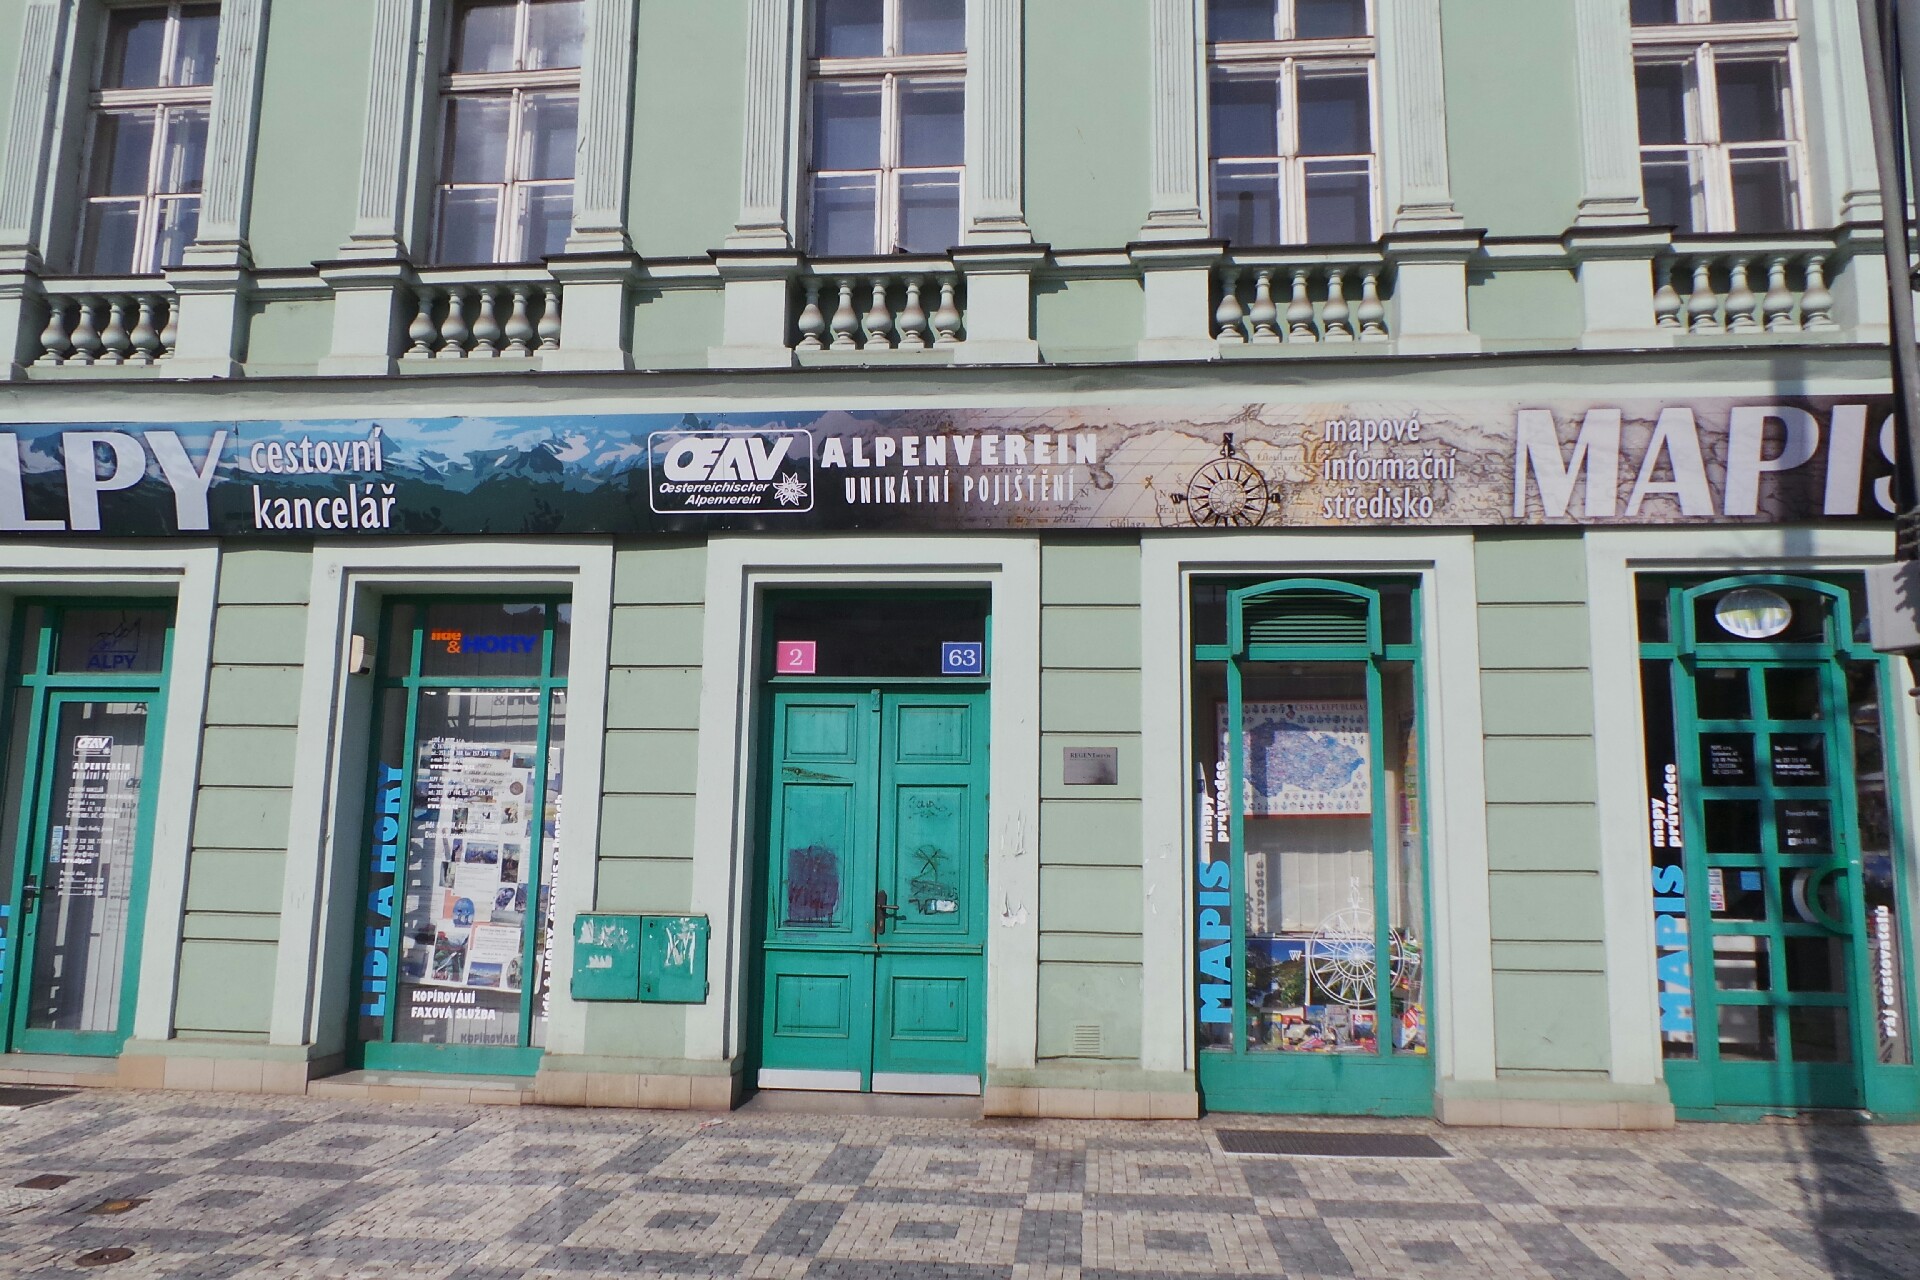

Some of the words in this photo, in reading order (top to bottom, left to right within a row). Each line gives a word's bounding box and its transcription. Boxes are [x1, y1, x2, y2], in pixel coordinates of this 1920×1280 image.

[1324, 410, 1420, 450] mapové
[250, 427, 383, 475] cestovní
[821, 433, 1097, 468] ALPENVEREIN
[1323, 449, 1457, 480] informační
[685, 494, 761, 506] Alpenverein
[845, 470, 950, 504] UNIKÁTNÍ
[964, 469, 1075, 506] POJIŠTĚNÍ
[1322, 487, 1434, 519] středisko
[254, 483, 397, 530] kancelář
[86, 654, 137, 670] ALPY
[447, 641, 461, 654] &
[461, 634, 538, 654] HORY
[789, 648, 803, 666] 2
[948, 649, 976, 667] 63
[370, 762, 403, 873] HORY
[1203, 796, 1214, 843] mapy
[1214, 761, 1230, 843] průvodce
[1664, 764, 1683, 848] průvodce
[1651, 798, 1666, 848] mapy
[367, 884, 394, 918] A
[1198, 860, 1231, 1024] MAPIS
[1652, 864, 1694, 1032] MAPIS
[1875, 904, 1895, 1006] cestovatelů
[410, 1005, 453, 1019] FAXOVÁ
[455, 1007, 496, 1021] SLUŽBA
[412, 989, 476, 1004] KOPÍROVÁNÍ
[1882, 1009, 1899, 1038] ráj
